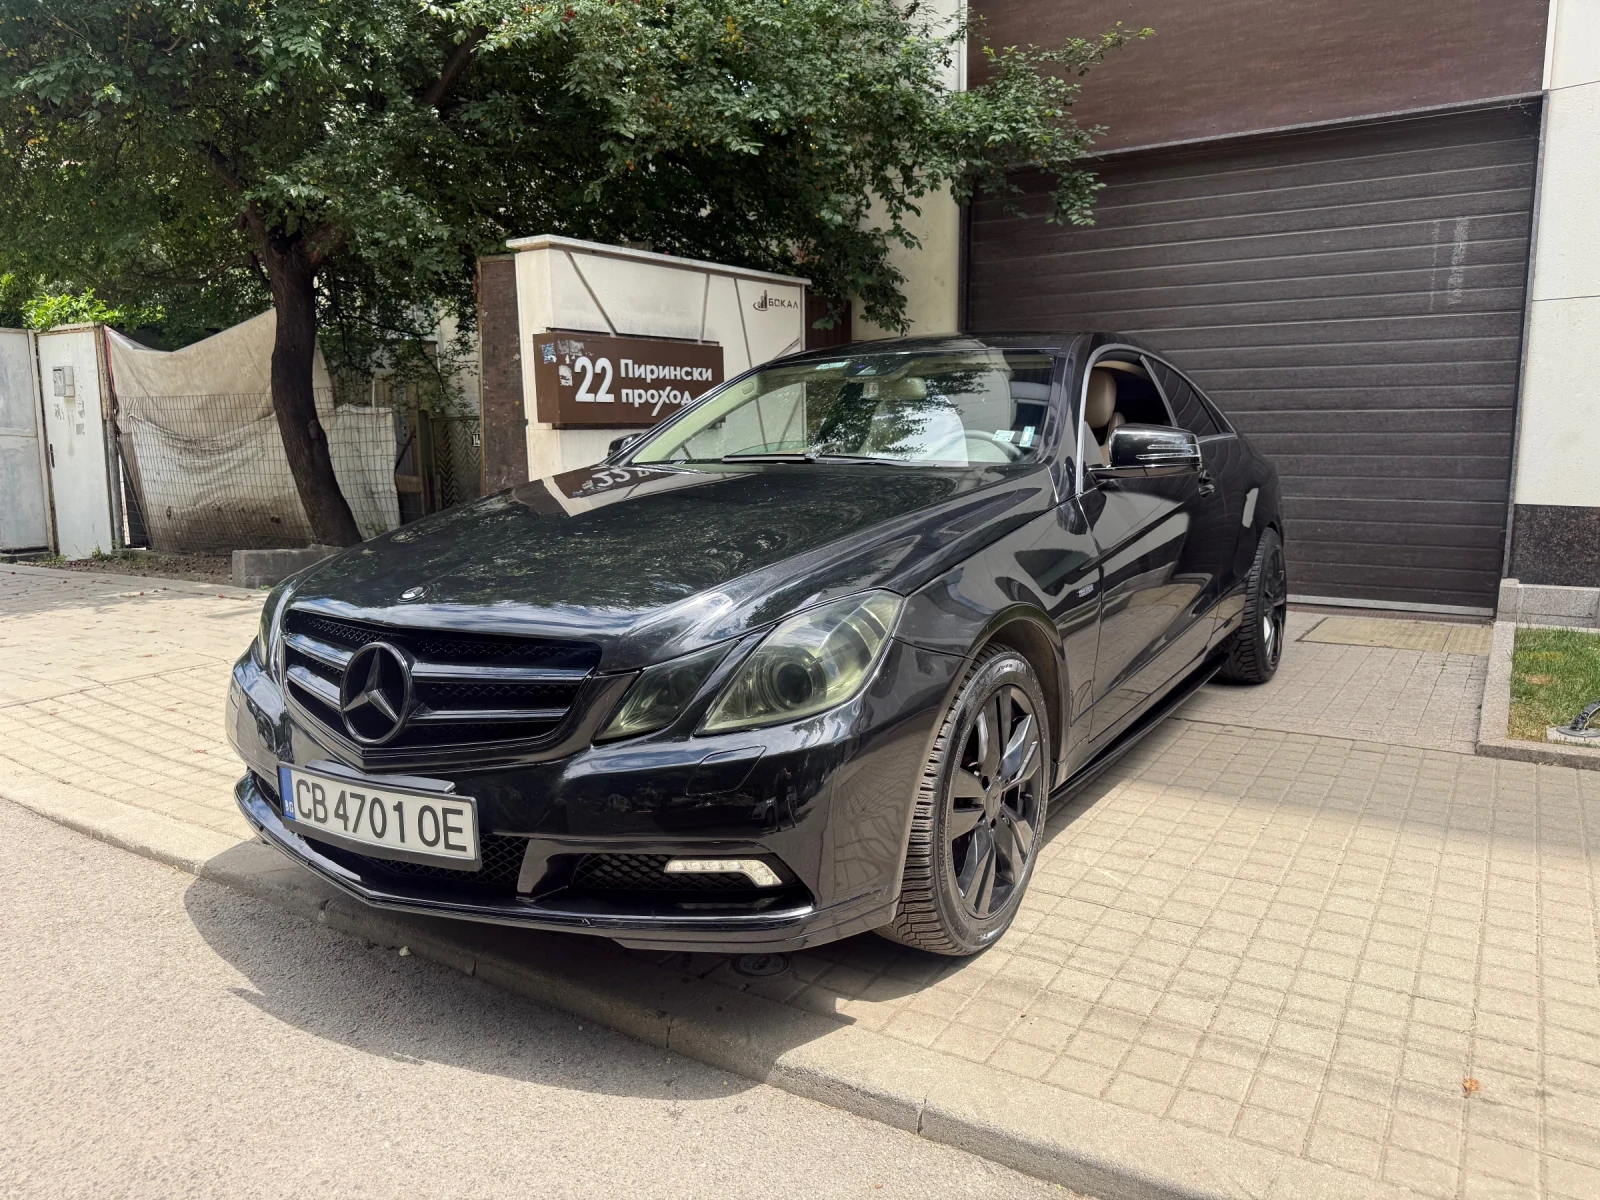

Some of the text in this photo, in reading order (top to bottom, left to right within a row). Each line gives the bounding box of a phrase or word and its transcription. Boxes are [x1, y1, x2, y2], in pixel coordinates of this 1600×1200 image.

[769, 298, 798, 309] БОКАЛ
[574, 356, 615, 403] 22
[620, 359, 712, 383] Пирински
[621, 386, 693, 416] проход
[285, 800, 294, 813] BG
